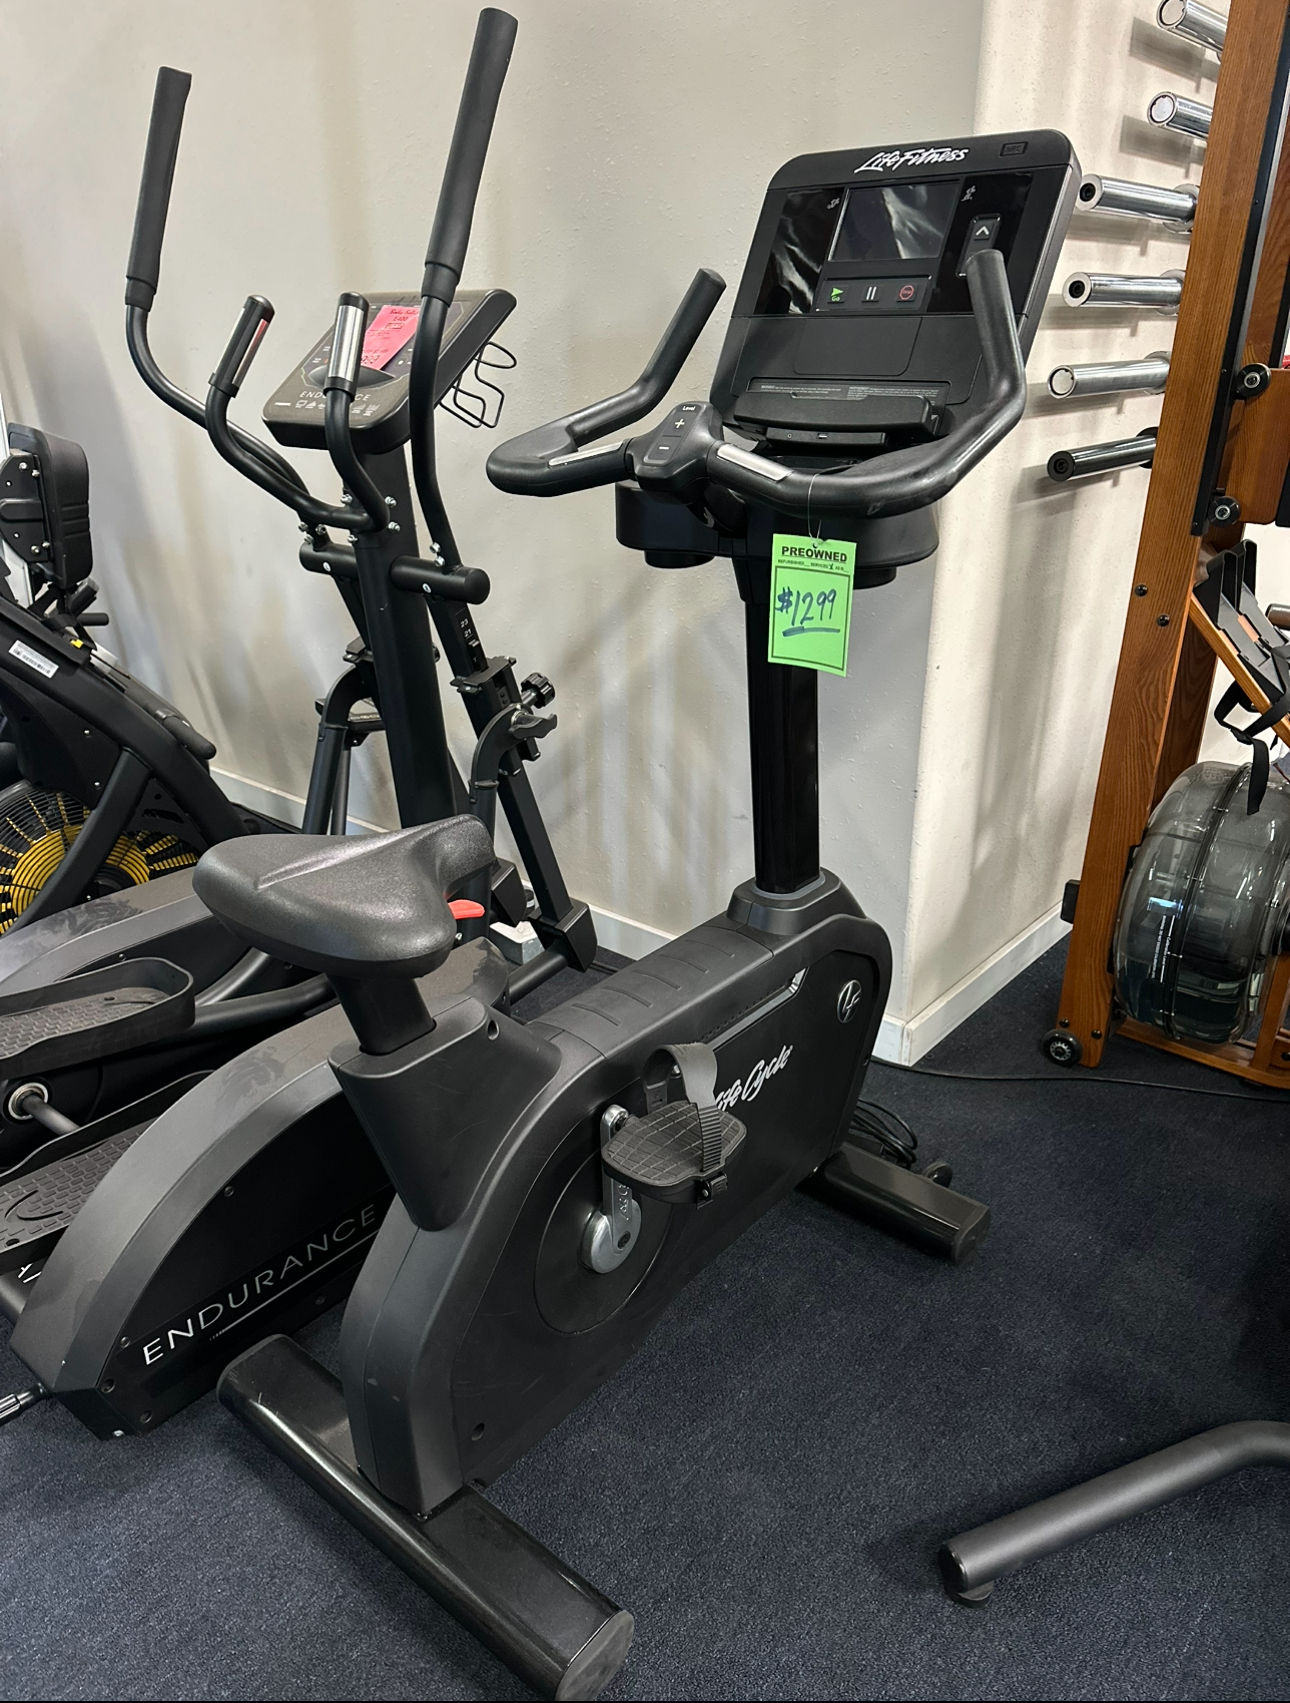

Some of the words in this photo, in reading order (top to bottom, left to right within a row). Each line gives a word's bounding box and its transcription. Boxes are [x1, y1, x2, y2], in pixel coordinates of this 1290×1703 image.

[781, 546, 847, 562] PREOWNED
[775, 586, 837, 627] $1299
[143, 1204, 376, 1365] ENDURANCE
